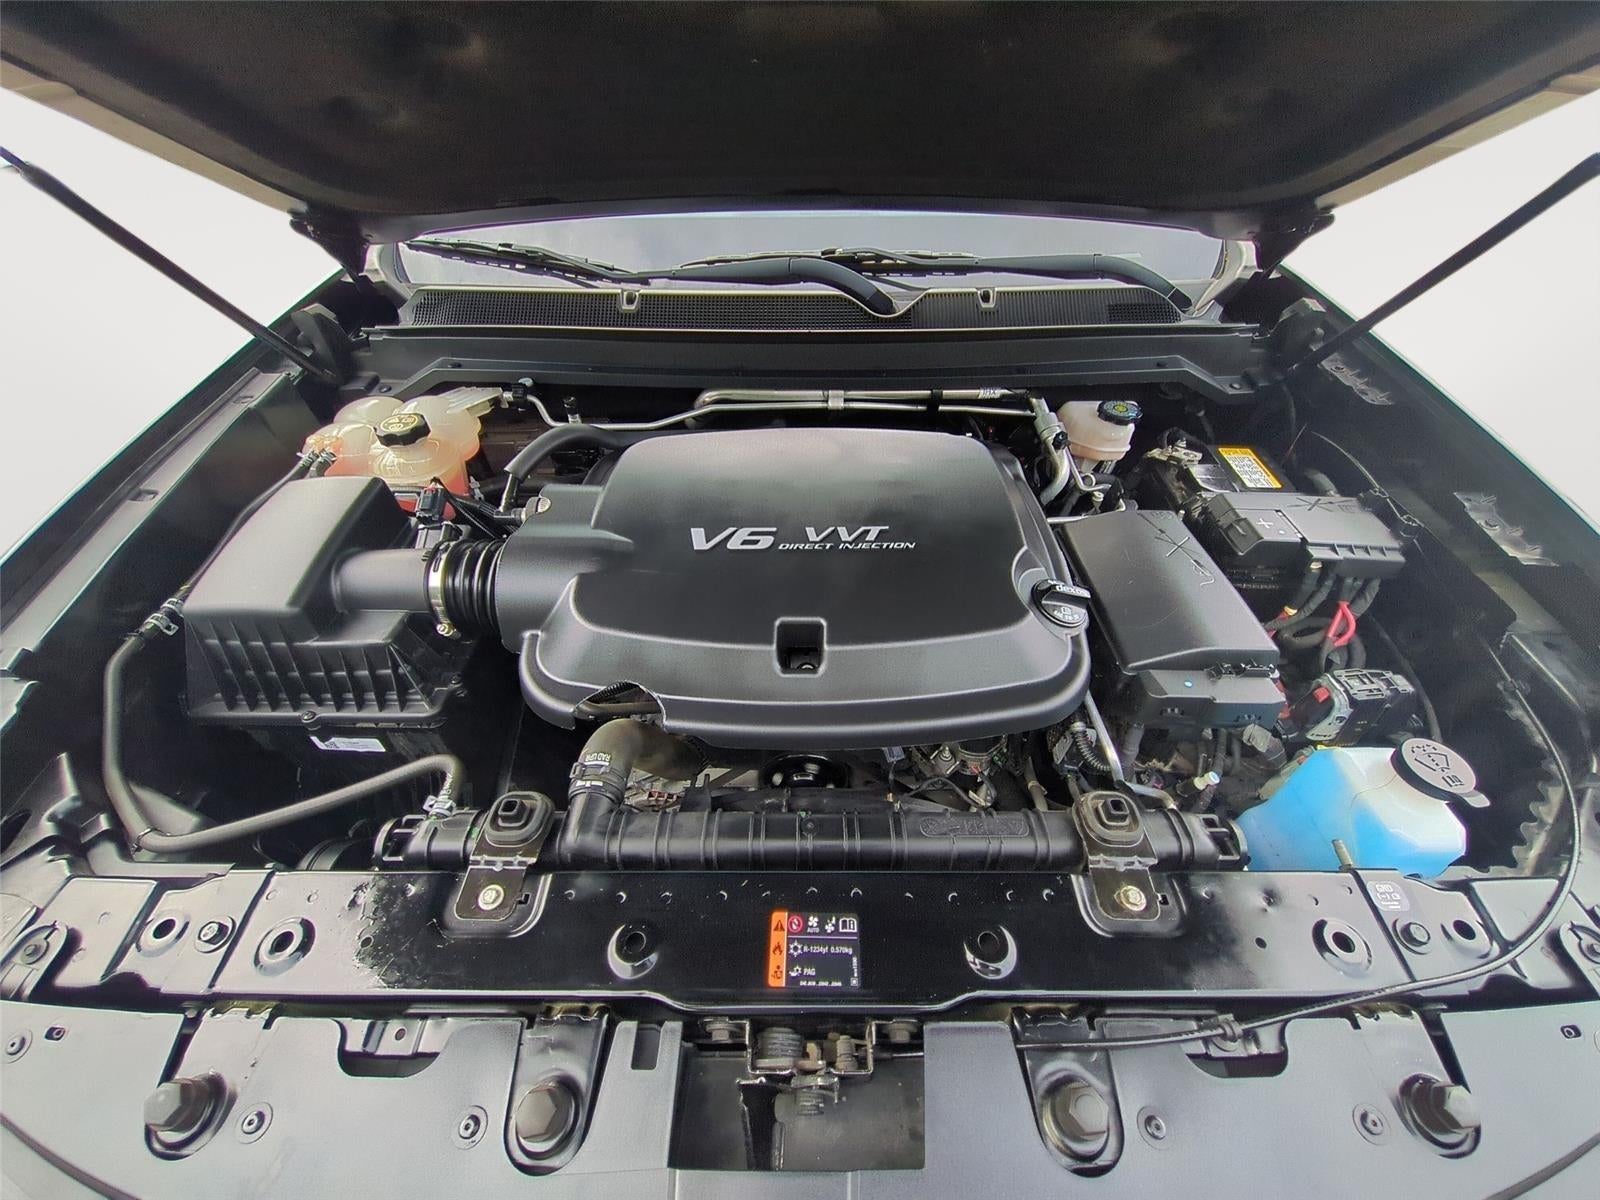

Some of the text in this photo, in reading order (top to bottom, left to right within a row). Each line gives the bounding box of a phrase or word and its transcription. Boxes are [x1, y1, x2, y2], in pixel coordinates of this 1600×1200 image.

[690, 526, 890, 551] V6 VVT
[778, 542, 834, 550] DIRECT
[803, 945, 828, 955] R-1234yf
[803, 967, 816, 976] PAG
